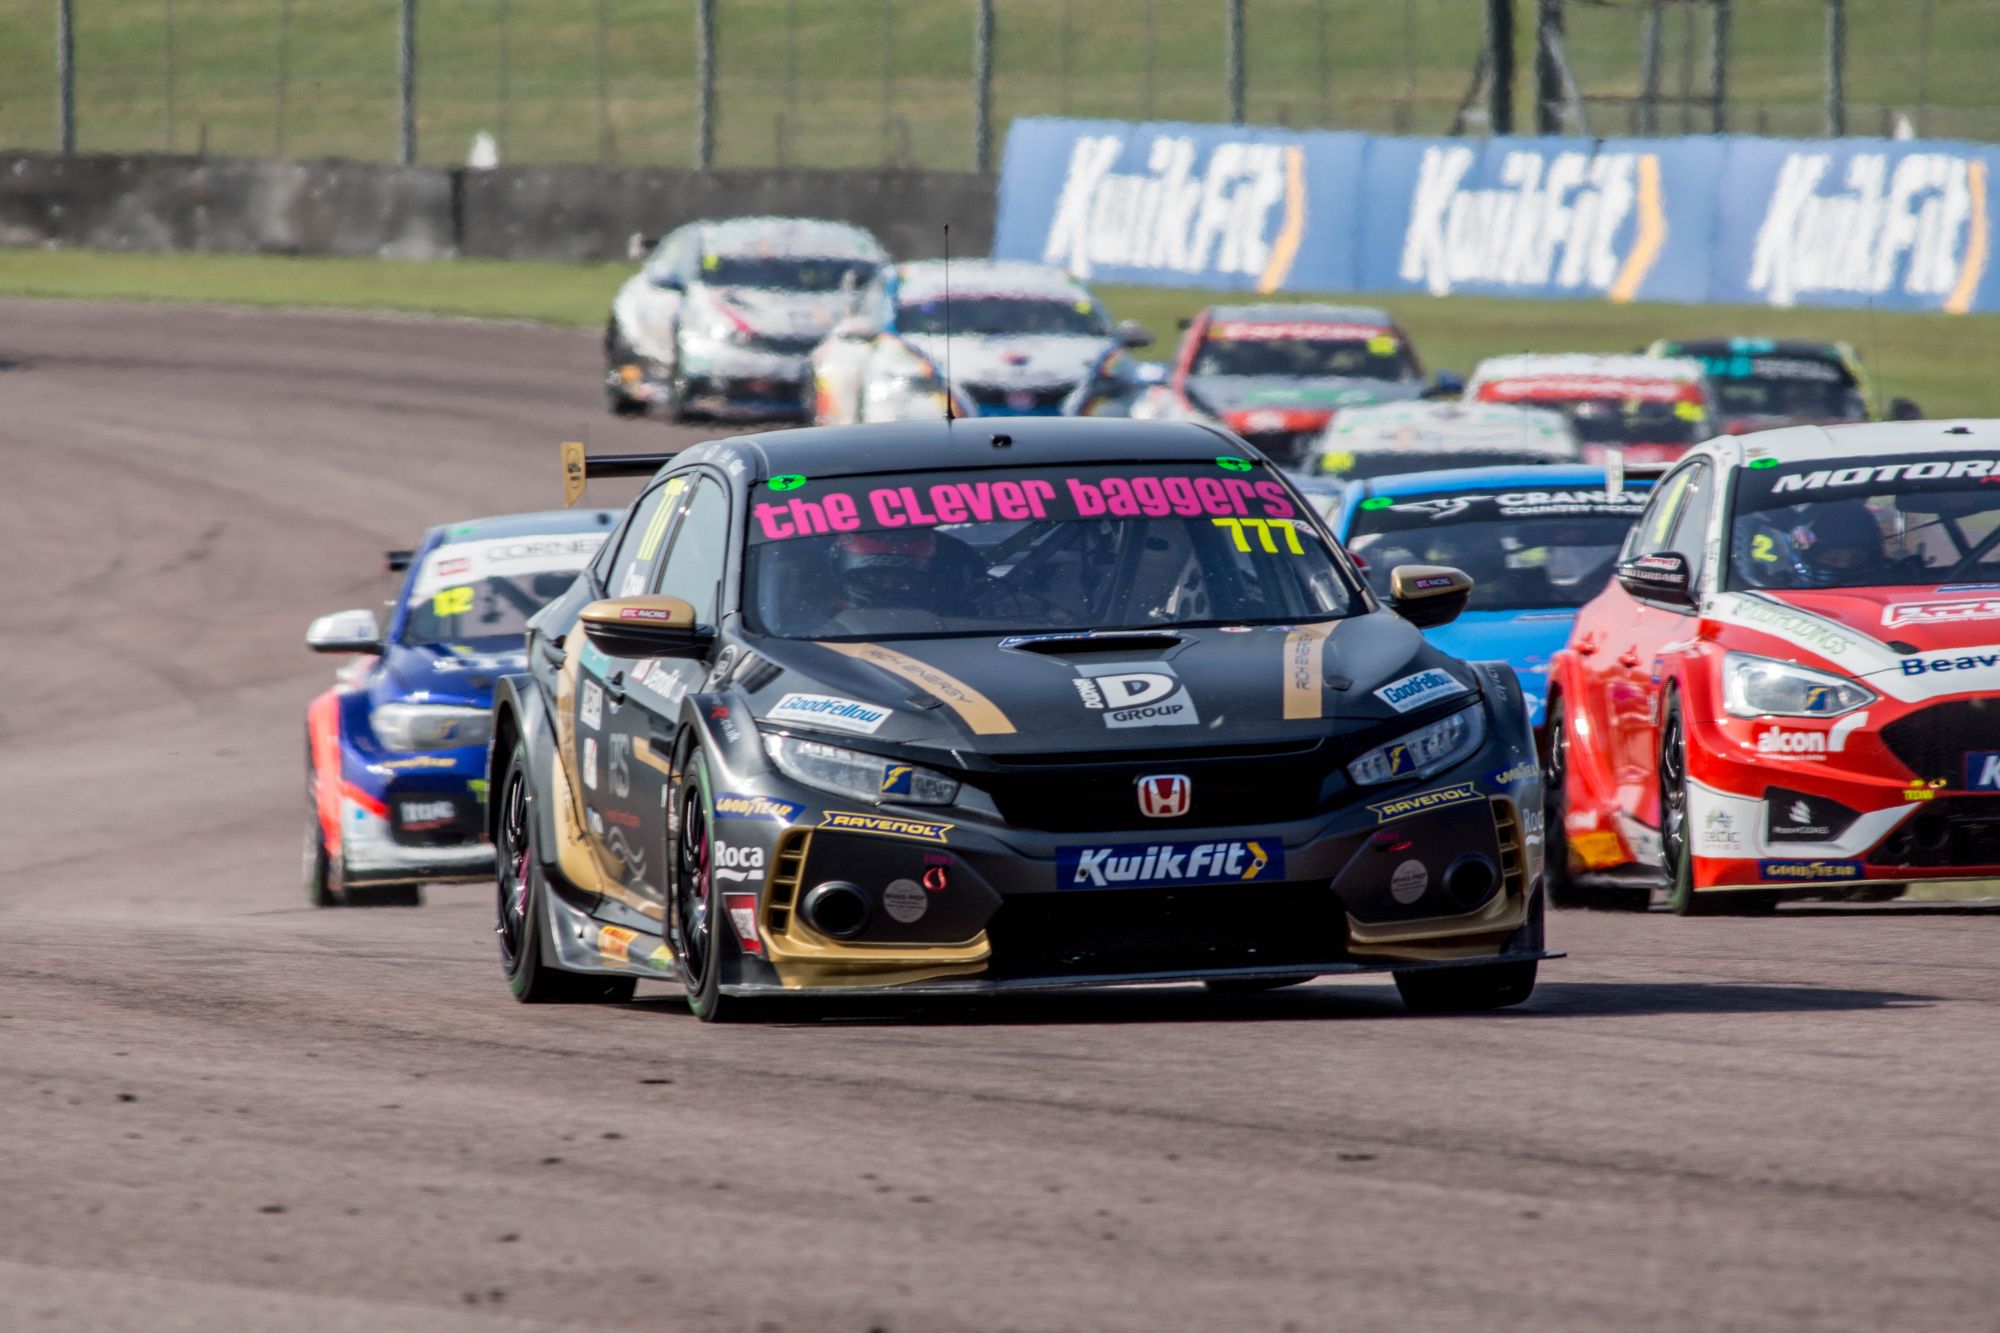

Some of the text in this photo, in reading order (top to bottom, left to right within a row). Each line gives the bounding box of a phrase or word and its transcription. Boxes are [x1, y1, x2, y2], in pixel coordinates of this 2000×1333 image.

[1772, 460, 2000, 493] MOTOR
[754, 493, 860, 539] the
[1066, 476, 1295, 518] baggers
[1212, 517, 1305, 554] 777
[1751, 534, 1778, 562] 2
[638, 610, 668, 619] RACING
[1113, 704, 1184, 722] GROUP
[1757, 725, 1826, 752] alcon
[715, 797, 794, 817] GOODYEAR
[1382, 788, 1471, 816] RAVENOL
[833, 815, 938, 836] RAVENOL
[715, 840, 764, 867] Roca
